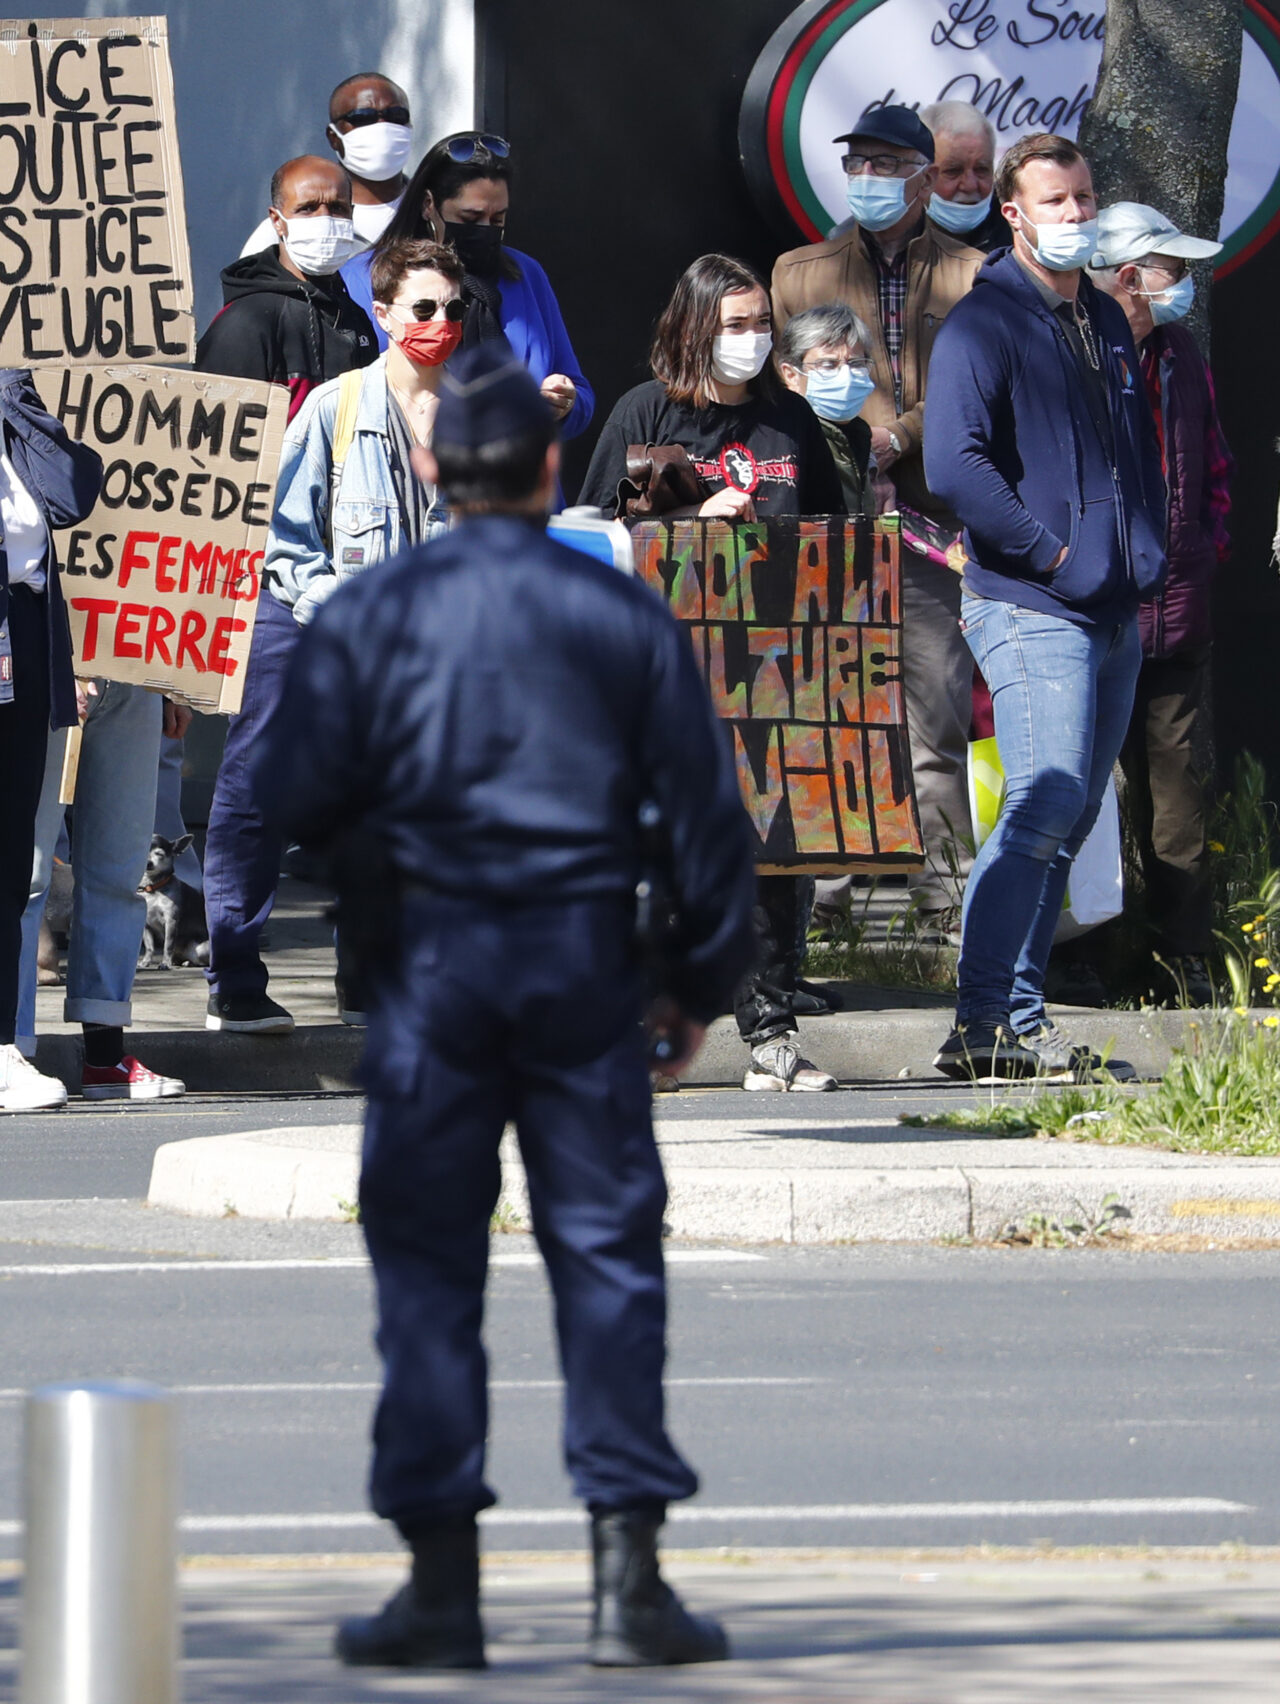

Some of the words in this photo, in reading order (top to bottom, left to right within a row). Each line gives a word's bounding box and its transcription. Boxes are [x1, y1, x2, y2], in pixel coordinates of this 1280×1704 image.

[931, 0, 999, 50] Le
[1007, 0, 1107, 48] Sou
[936, 74, 1093, 134] Magh
[56, 370, 268, 461] HOMME
[100, 455, 272, 527] OSSÈDE
[117, 530, 265, 600] FEMMES
[70, 598, 247, 676] TERRE
[691, 625, 903, 725] LTURE
